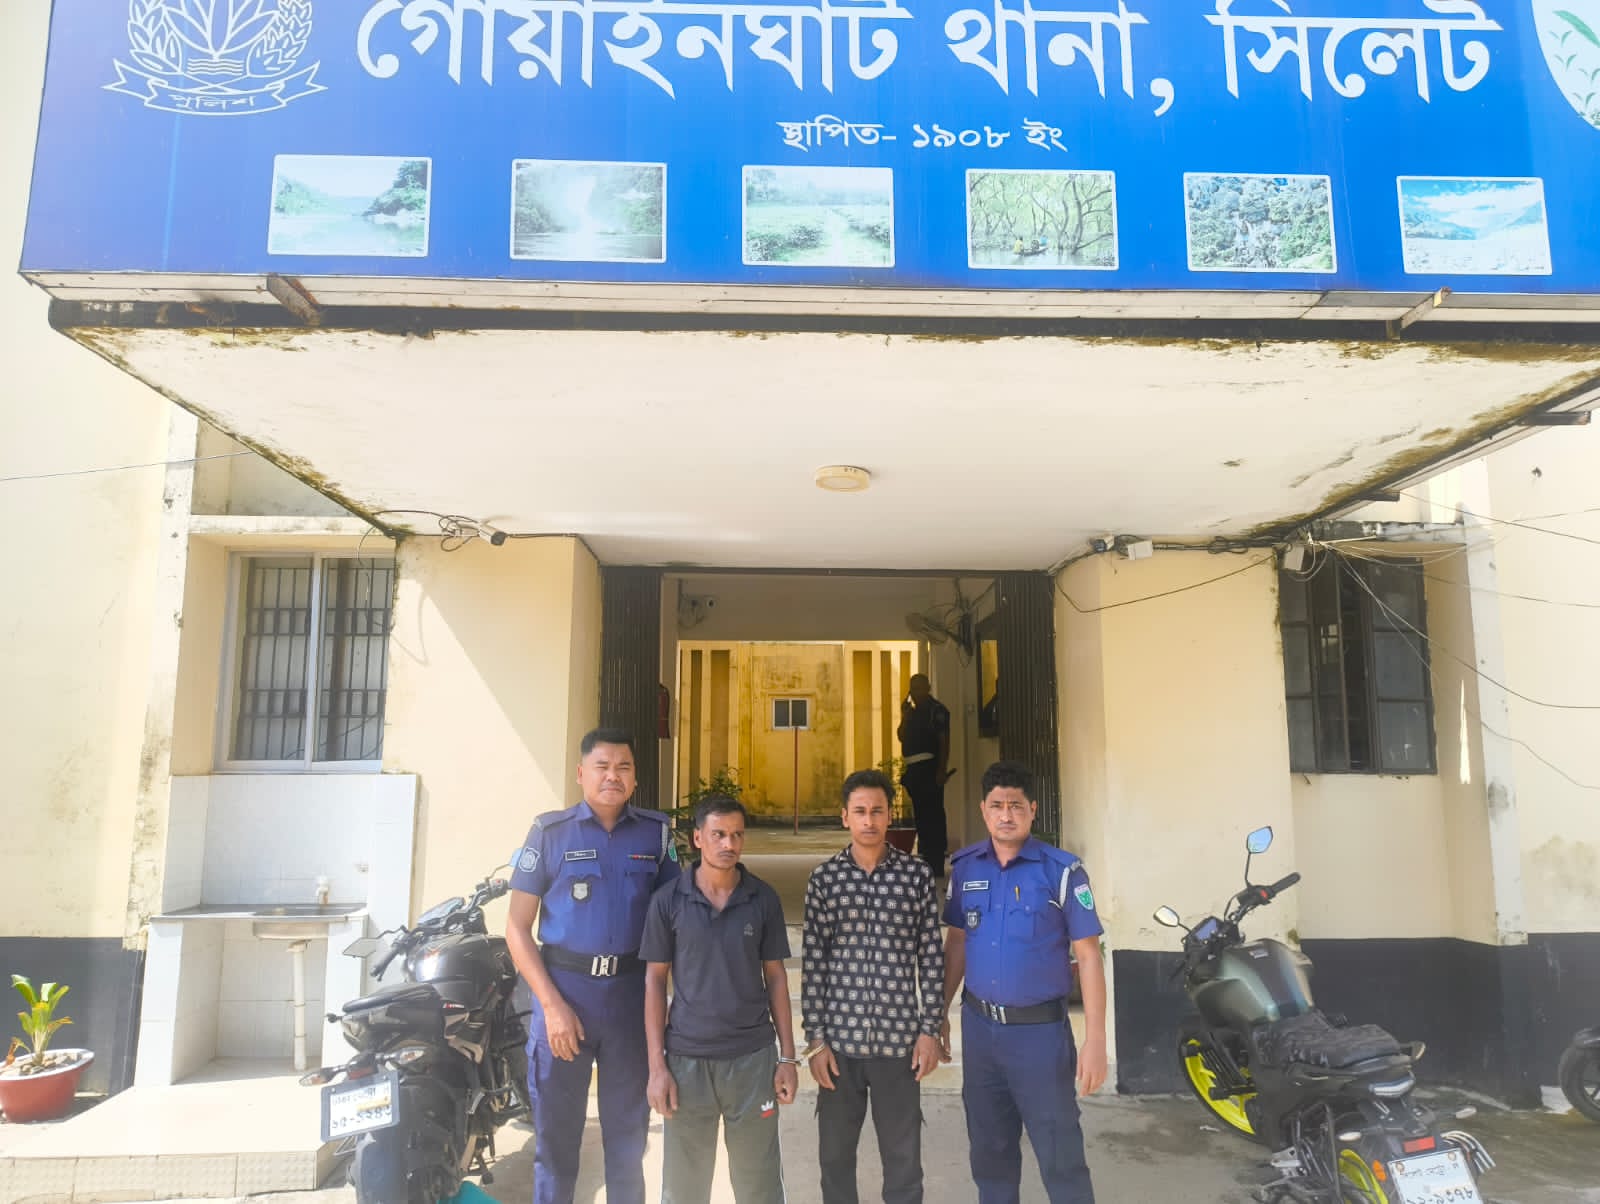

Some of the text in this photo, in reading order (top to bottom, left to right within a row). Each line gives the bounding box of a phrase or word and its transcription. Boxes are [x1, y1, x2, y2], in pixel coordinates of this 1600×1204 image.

[357, 0, 1504, 117] গোয়াইনঘাট থানা, সিলেট
[775, 114, 1069, 153] স্থাপিত- ১৯০৮ ইং
